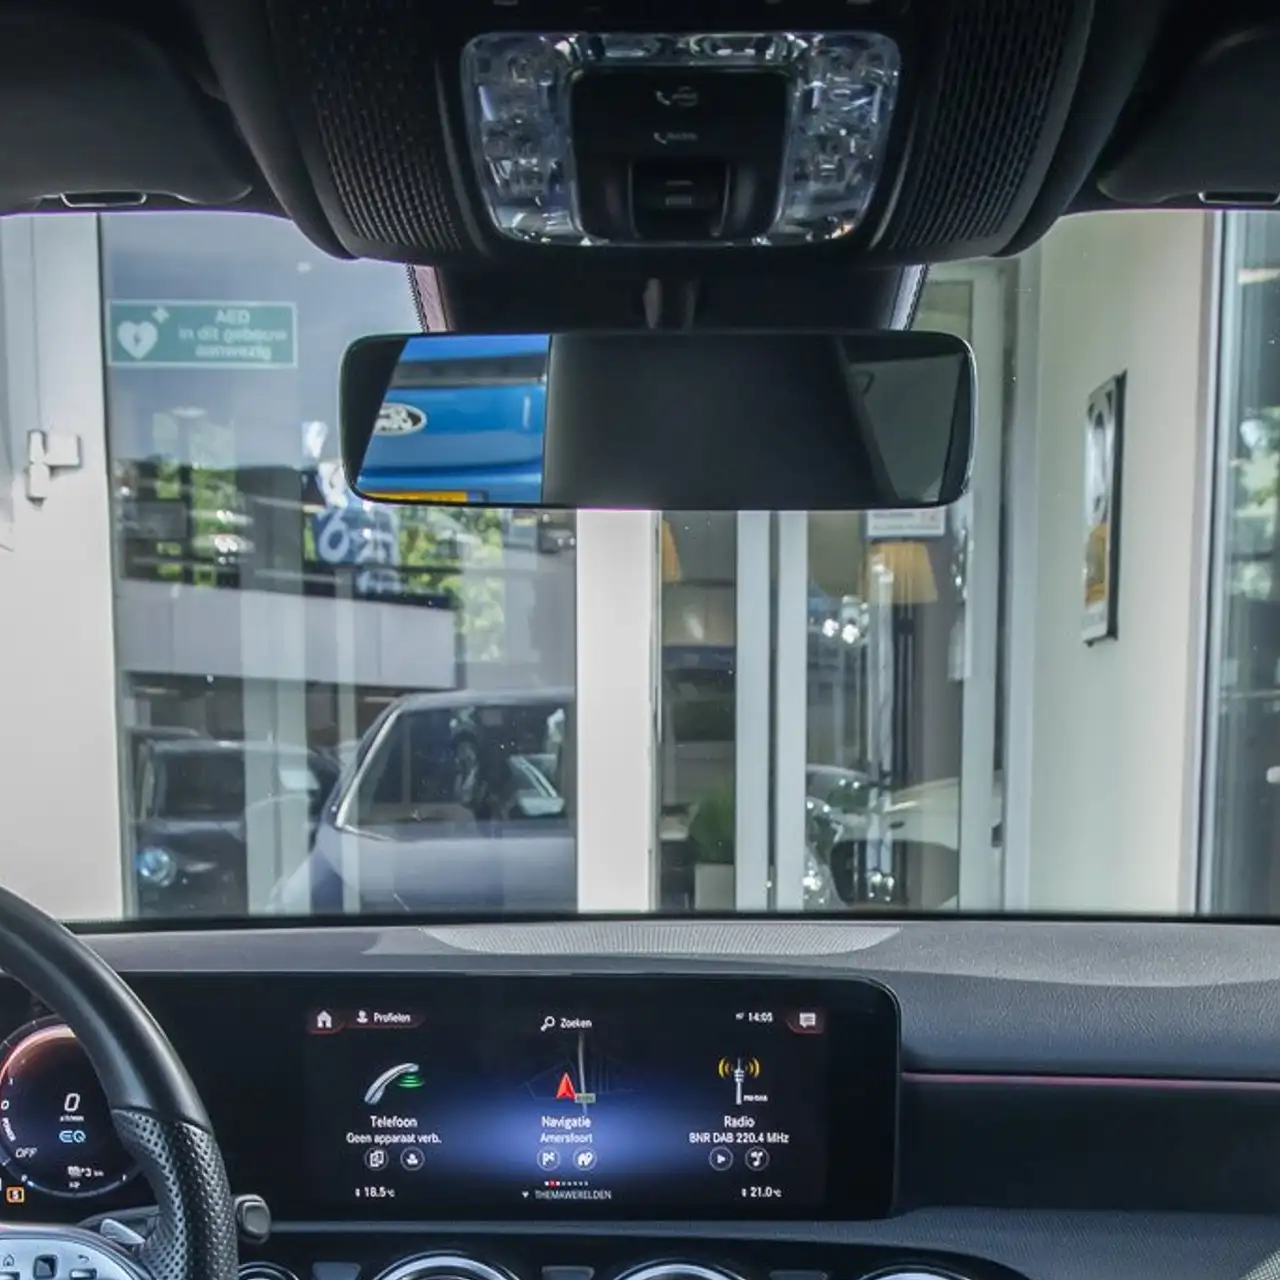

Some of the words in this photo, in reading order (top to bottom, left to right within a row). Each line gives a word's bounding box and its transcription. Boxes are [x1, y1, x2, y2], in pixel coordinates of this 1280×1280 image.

[214, 308, 251, 325] AED
[178, 326, 194, 340] in
[196, 326, 219, 341] dit
[373, 1012, 411, 1023] Profielen
[560, 1018, 592, 1028] Zoeken
[64, 1093, 80, 1112] 0
[370, 1115, 418, 1128] Telefoon
[541, 1115, 592, 1130] Navigatie
[724, 1115, 756, 1128] Radio
[346, 1132, 372, 1143] Geen
[374, 1133, 416, 1145] apparaat
[417, 1133, 442, 1143] verb.
[540, 1133, 593, 1143] Amersfoort
[688, 1132, 711, 1143] BNR
[713, 1132, 734, 1143] DAB
[736, 1132, 765, 1143] 220.4
[766, 1132, 790, 1143] MHz
[15, 1147, 38, 1159] OFF
